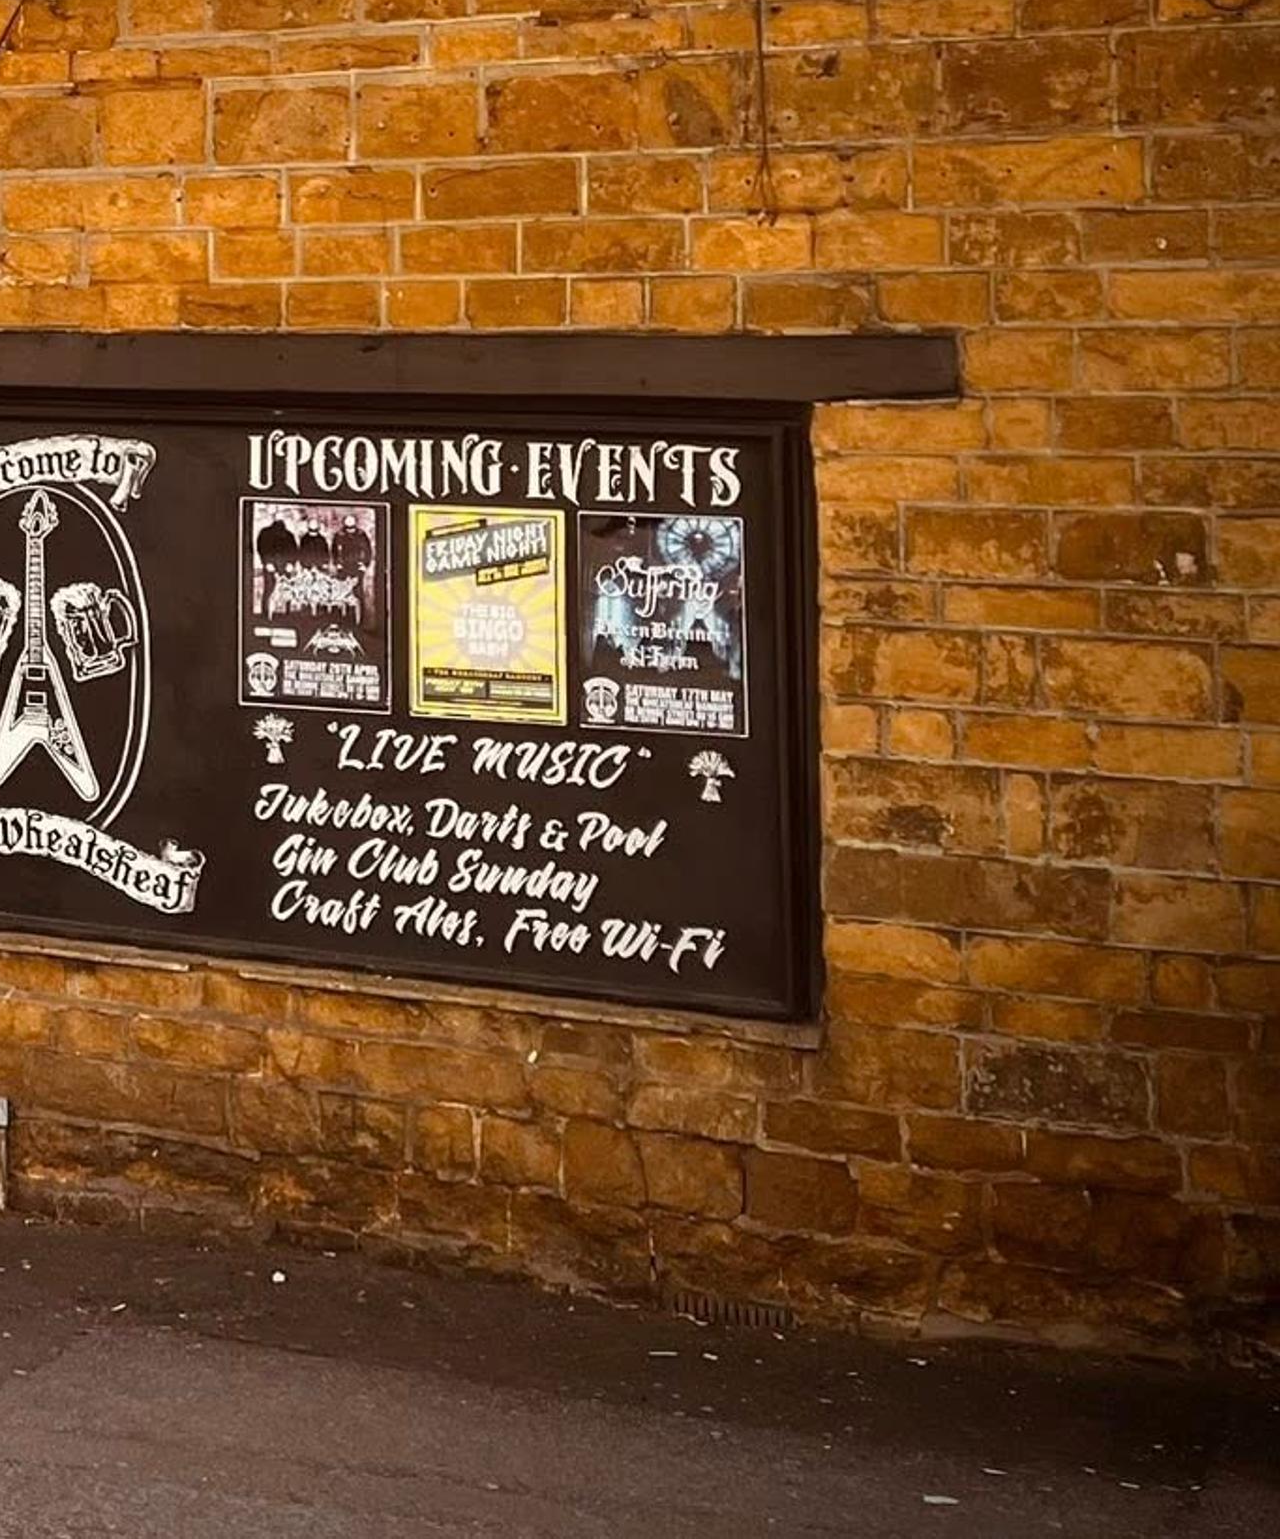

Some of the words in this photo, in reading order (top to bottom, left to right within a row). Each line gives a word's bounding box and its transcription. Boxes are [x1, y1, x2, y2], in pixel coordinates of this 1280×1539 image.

[90, 437, 121, 476] to
[248, 429, 503, 499] UPCOMING
[525, 438, 741, 507] EVENTS
[426, 552, 481, 573] GAME
[427, 531, 488, 558] FRIDAY
[493, 521, 548, 544] NIGHT
[454, 619, 524, 642] BINGO
[254, 783, 415, 837] Jukebox,
[424, 797, 532, 850] Darts
[540, 819, 569, 852] &
[577, 811, 668, 858] Pool
[272, 833, 338, 877] Gin
[347, 837, 440, 886] Club
[448, 849, 599, 913] Sunday
[271, 880, 381, 935] Craft
[504, 908, 591, 954] Free
[600, 918, 726, 974] Wi-Fi
